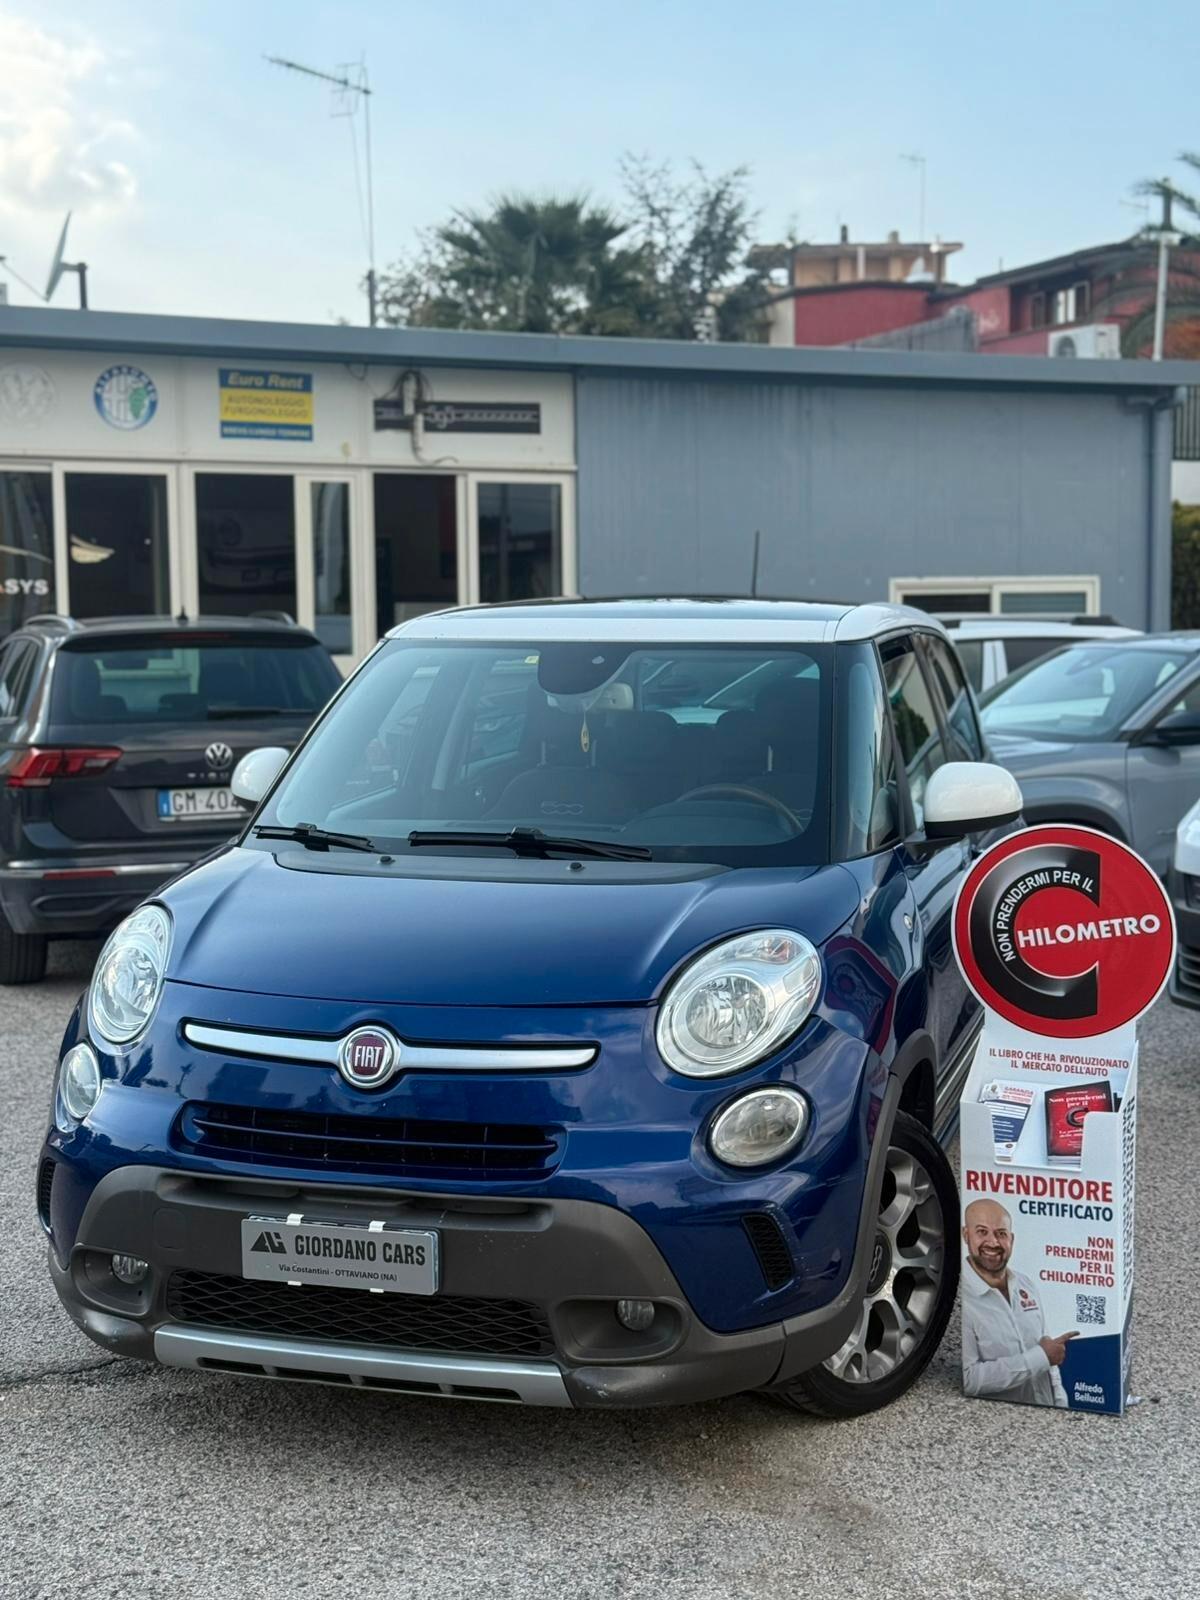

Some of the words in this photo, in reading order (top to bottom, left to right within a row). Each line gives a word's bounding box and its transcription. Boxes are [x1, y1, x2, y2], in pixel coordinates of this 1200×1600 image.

[228, 372, 265, 387] Euro
[268, 374, 304, 390] Rent
[0, 578, 49, 595] SYS
[1053, 870, 1080, 886] PER
[1082, 877, 1094, 893] IL
[996, 871, 1050, 929] PRENDERMI
[997, 933, 1016, 962] NON
[354, 1045, 383, 1068] FIAT
[989, 1048, 997, 1057] IL
[998, 1049, 1024, 1059] LIBRO
[1025, 1051, 1042, 1061] CHE
[1044, 1053, 1056, 1062] HA
[1059, 1054, 1129, 1069] RIVOLUZIONATO
[1010, 1060, 1018, 1068] IL
[1022, 1061, 1062, 1073] MERCATO
[1064, 1066, 1108, 1077] DELL'AUTO
[966, 1170, 1113, 1203] RIVENDITORE
[1019, 1200, 1113, 1222] CERTIFICATO
[295, 1234, 377, 1261] GIORDANO
[382, 1242, 426, 1266] CARS
[1087, 1236, 1114, 1249] NON
[1045, 1245, 1114, 1262] PRENDERMI
[279, 1263, 291, 1273] Via
[292, 1264, 330, 1276] Costantini
[335, 1269, 379, 1280] OTTAVIANO
[380, 1272, 398, 1282] (NA)
[1080, 1261, 1101, 1274] PER
[1104, 1263, 1115, 1275] IL
[1039, 1269, 1115, 1288] CHILOMETRO
[1074, 1382, 1103, 1394] Alfredo
[1074, 1391, 1105, 1404] Bellucci
